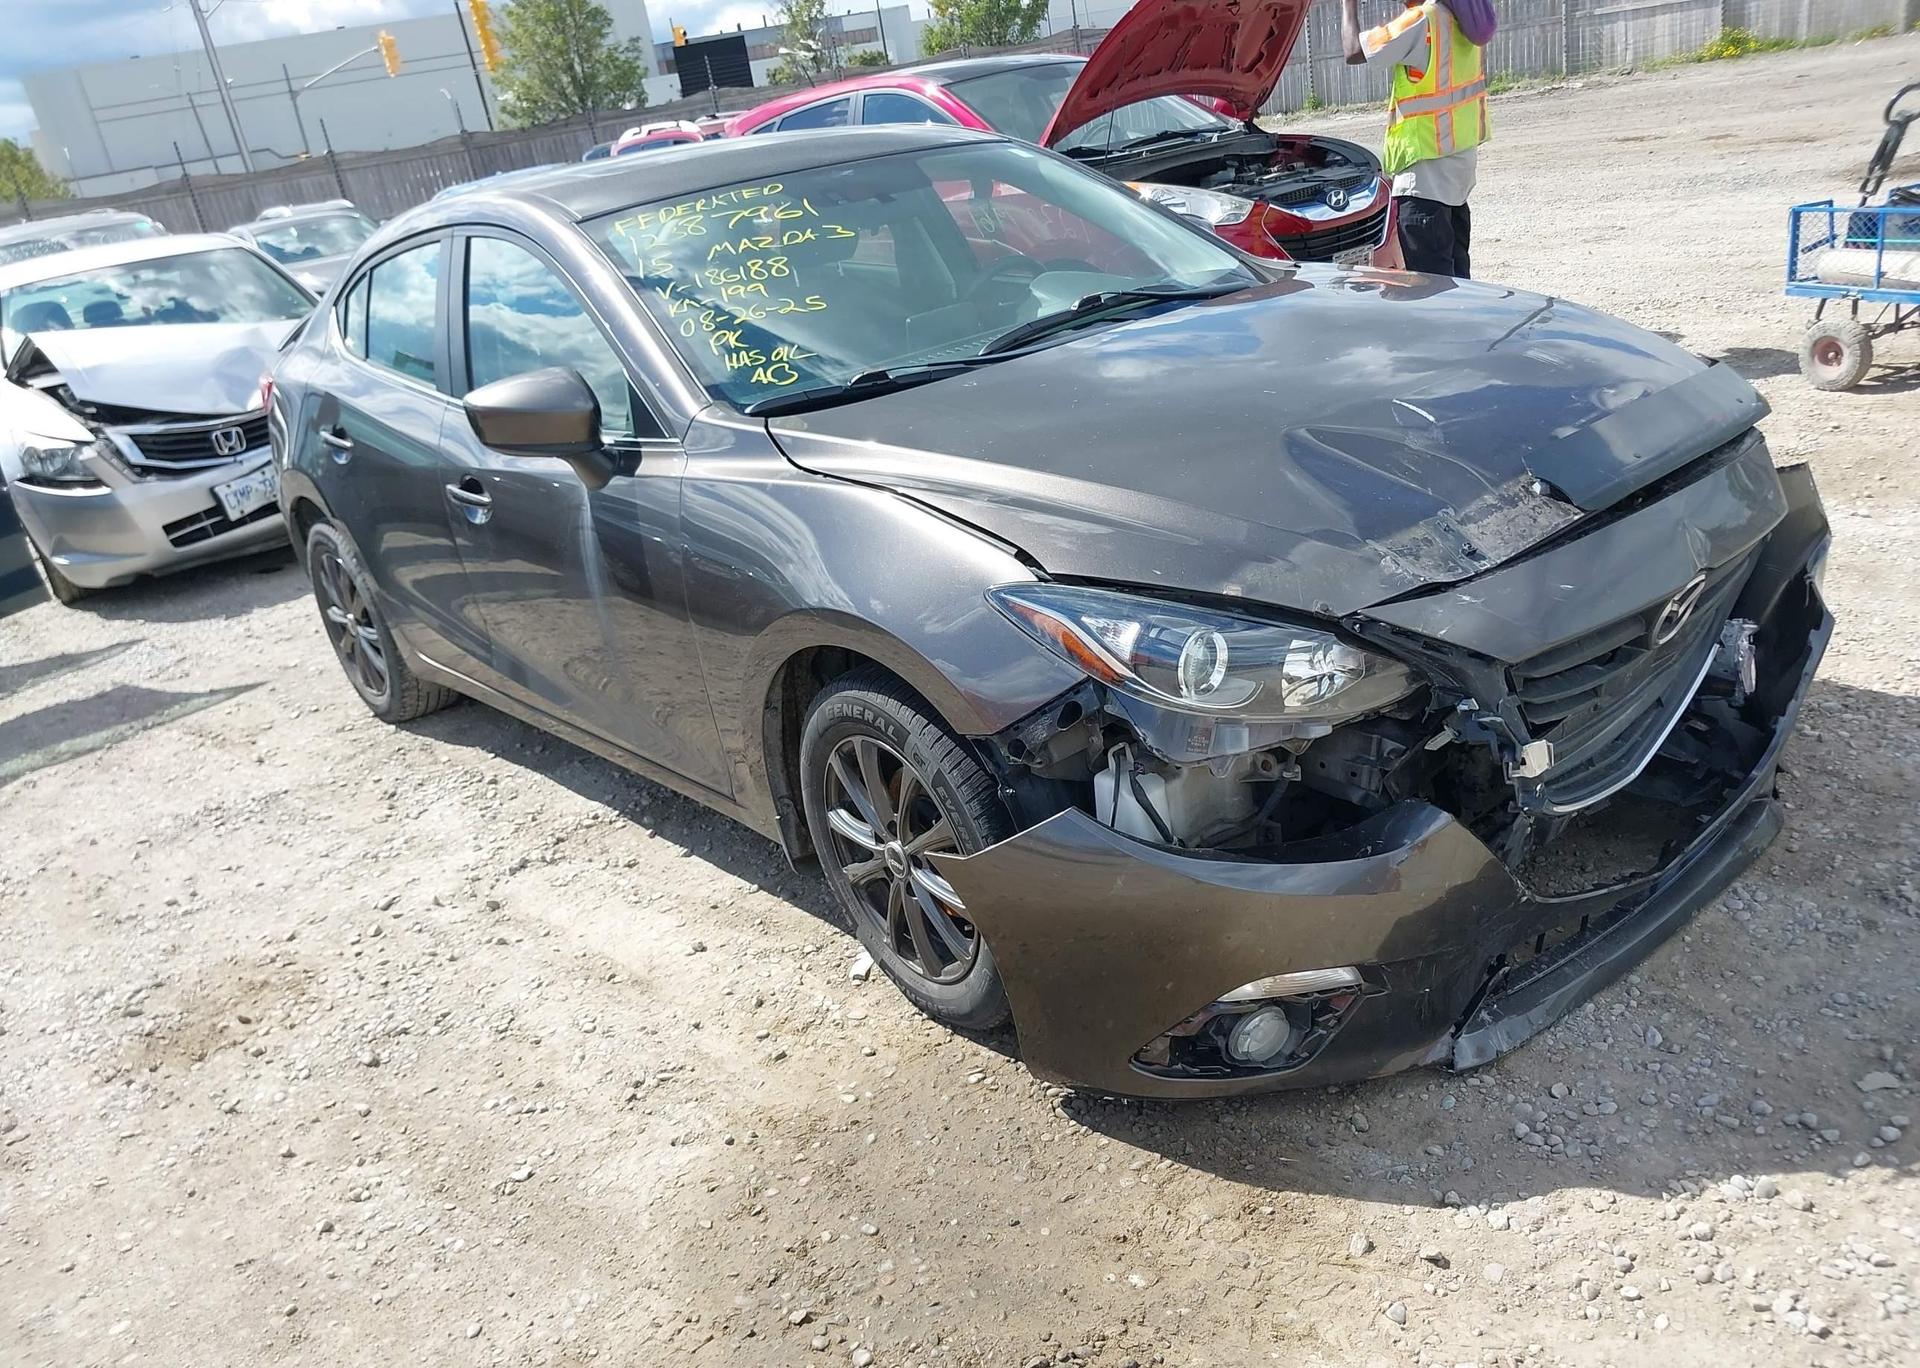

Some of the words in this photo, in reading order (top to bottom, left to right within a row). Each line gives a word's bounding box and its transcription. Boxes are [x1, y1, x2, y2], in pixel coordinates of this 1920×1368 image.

[707, 231, 818, 261] MAZDA
[680, 295, 828, 337] 08-26-25
[724, 349, 766, 371] HAS
[771, 344, 818, 362] OIL
[825, 703, 899, 742] GENERAL
